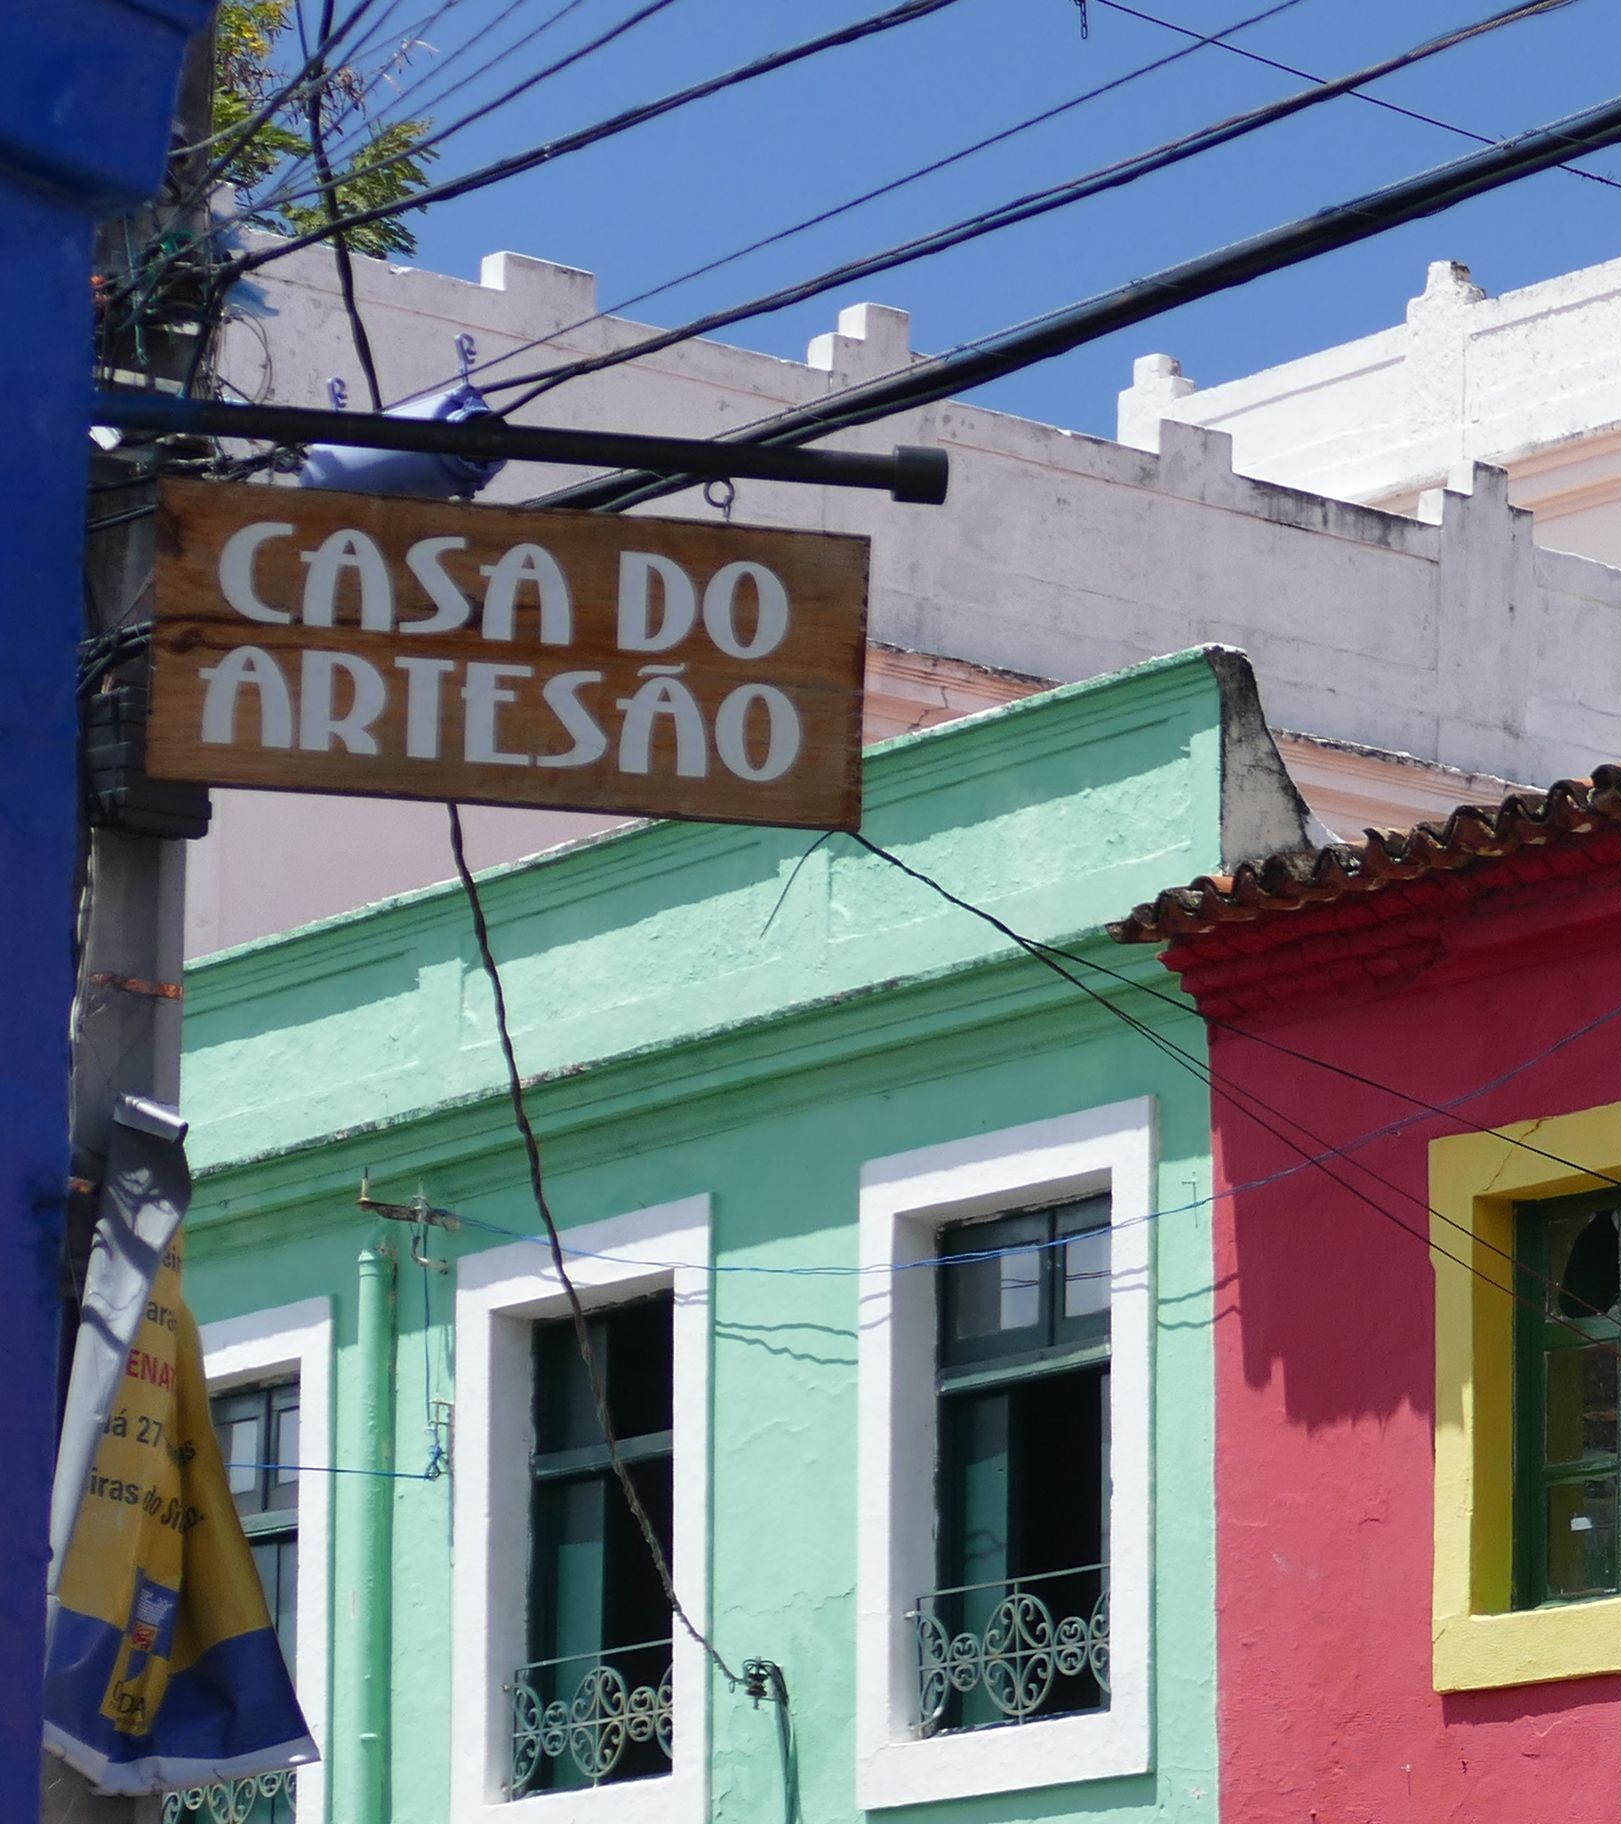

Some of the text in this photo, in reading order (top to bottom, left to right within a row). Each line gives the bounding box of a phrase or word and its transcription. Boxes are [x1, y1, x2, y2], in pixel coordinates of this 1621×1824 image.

[218, 521, 789, 659] CASA DO
[200, 645, 802, 782] ARTESÃO
[136, 1416, 162, 1447] 27
